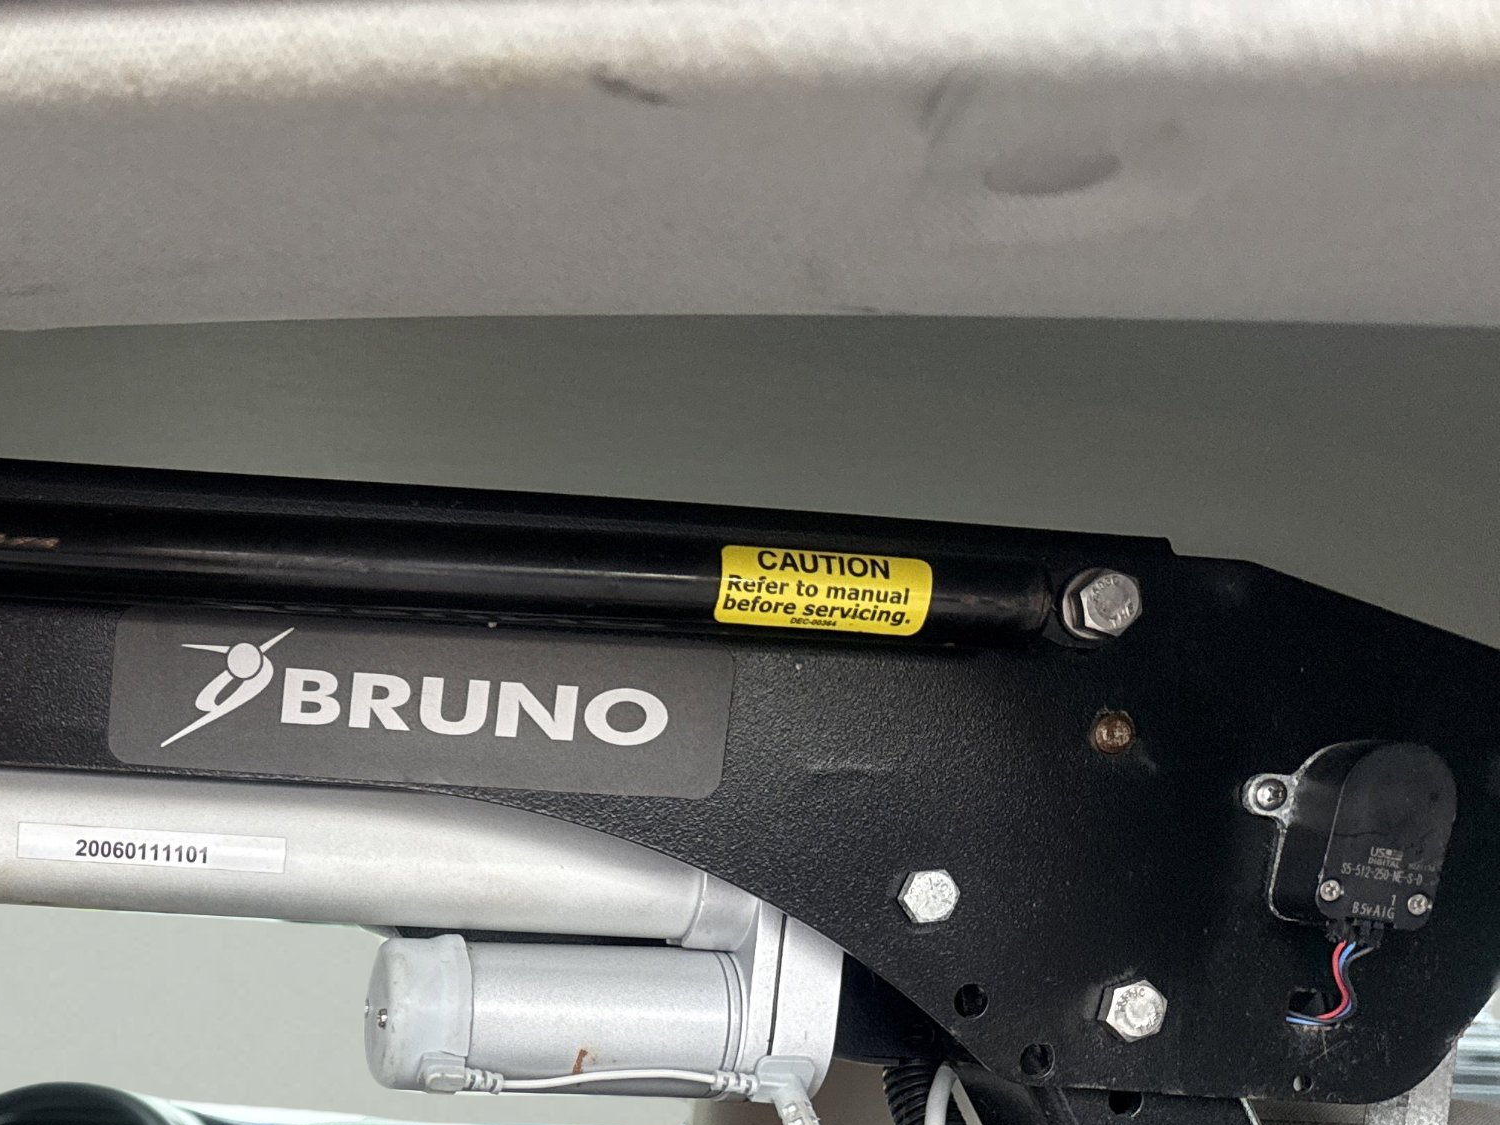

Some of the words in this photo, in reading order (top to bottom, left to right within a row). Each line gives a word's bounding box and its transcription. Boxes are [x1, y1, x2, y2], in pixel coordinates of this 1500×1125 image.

[757, 550, 890, 579] CAUTION
[727, 574, 789, 595] Refer
[796, 580, 818, 598] to
[826, 585, 910, 605] manual
[722, 594, 797, 615] before
[802, 603, 911, 626] servicing.
[280, 667, 669, 747] BRUNO
[75, 839, 209, 864] 20060111101
[1368, 857, 1400, 869] DIGITAL
